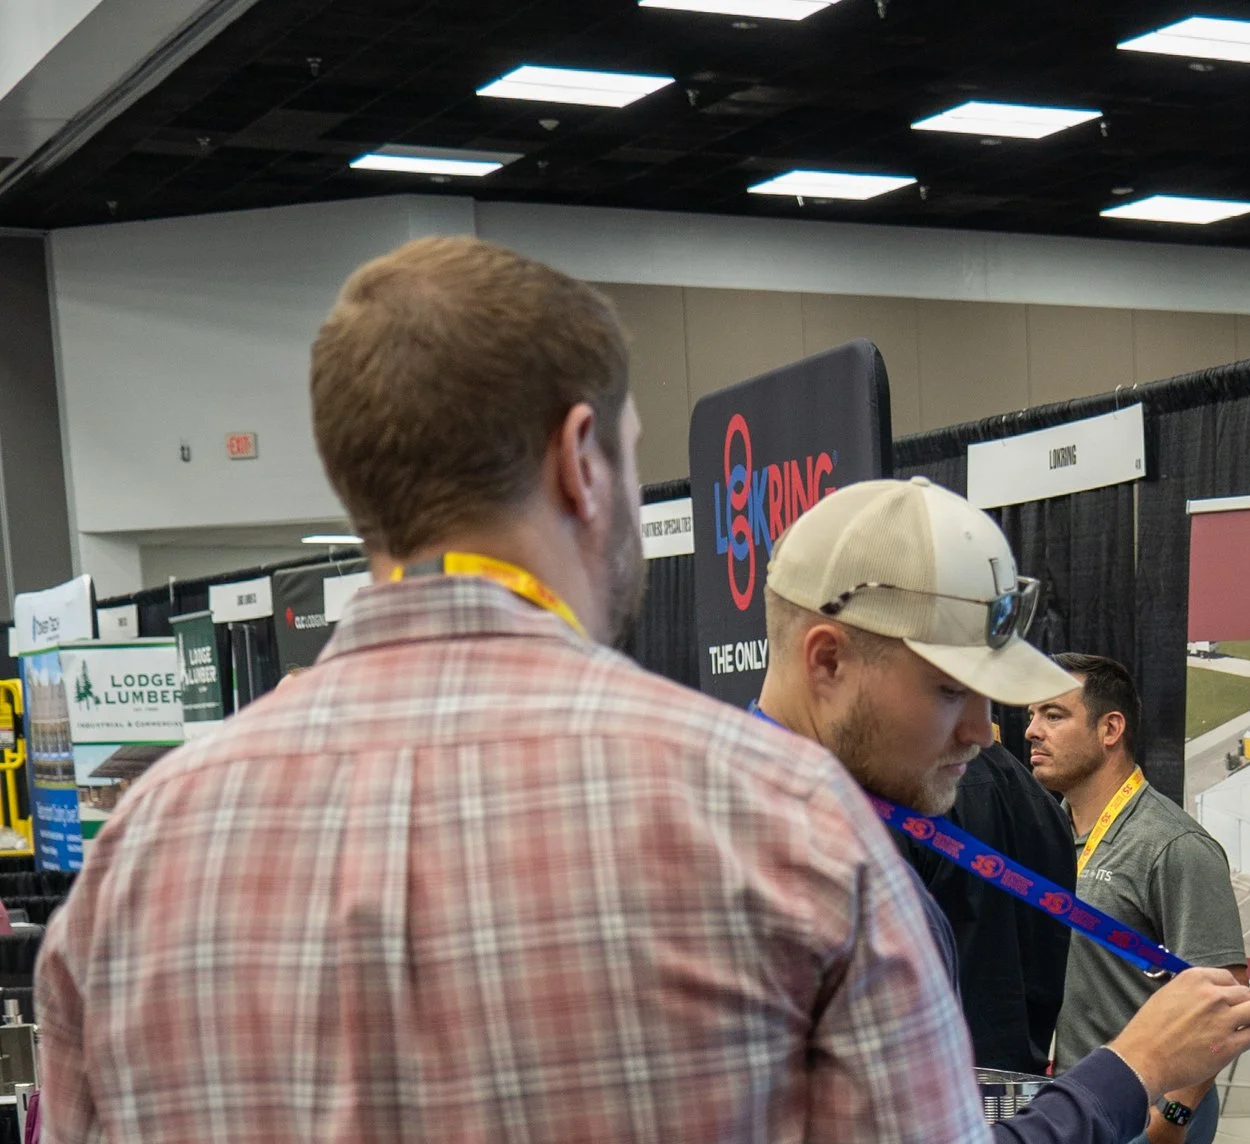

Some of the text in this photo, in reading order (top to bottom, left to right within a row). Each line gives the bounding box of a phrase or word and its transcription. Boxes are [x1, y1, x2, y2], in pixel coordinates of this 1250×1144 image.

[1049, 444, 1078, 471] LOKRING
[708, 638, 768, 675] THE ONLY
[110, 673, 176, 688] LODGE
[104, 688, 182, 705] LUMBER
[1096, 868, 1112, 882] ITS
